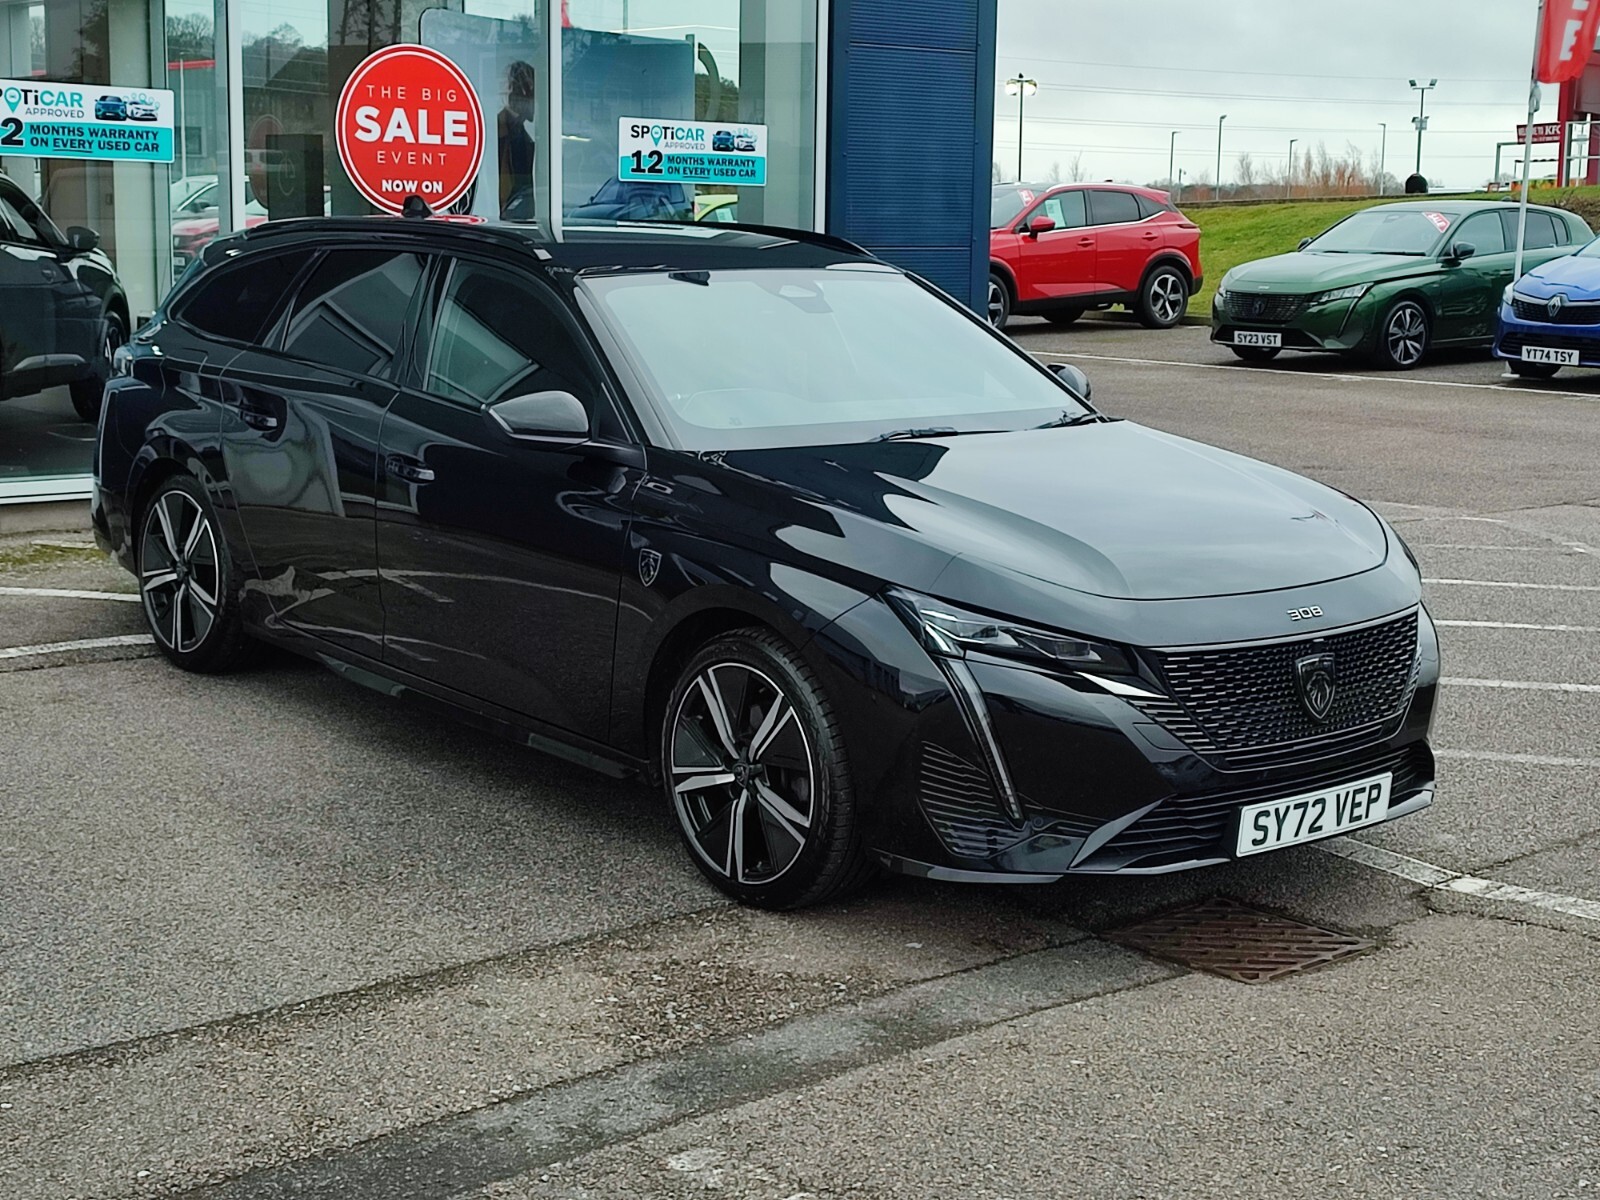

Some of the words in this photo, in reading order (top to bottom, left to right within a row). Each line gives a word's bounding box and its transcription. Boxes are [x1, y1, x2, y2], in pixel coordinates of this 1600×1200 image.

[366, 84, 406, 100] THE
[422, 88, 457, 102] BIG
[25, 107, 85, 118] APPROVED
[30, 124, 84, 137] MONTHS
[88, 128, 159, 141] WARRANTY
[354, 105, 469, 146] SALE
[30, 137, 49, 147] ON
[53, 139, 94, 150] EVERY
[98, 141, 131, 151] USED
[134, 142, 160, 153] CAR
[664, 142, 706, 150] APPROVED
[377, 150, 447, 165] EVENT
[631, 150, 663, 174] 12
[667, 155, 705, 166] MONTHS
[707, 158, 756, 168] WARRANTY
[667, 166, 681, 175] ON
[683, 167, 711, 176] EVERY
[714, 168, 737, 177] USED
[739, 169, 756, 178] CAR
[382, 179, 418, 192] NOW
[422, 180, 443, 193] ON
[1237, 333, 1259, 344] SY23
[1260, 334, 1278, 345] VST
[1525, 348, 1551, 361] YT74
[1554, 350, 1573, 363] TSY
[1286, 605, 1324, 621] 308
[1251, 797, 1327, 846] SY72
[1336, 783, 1382, 827] VEP
